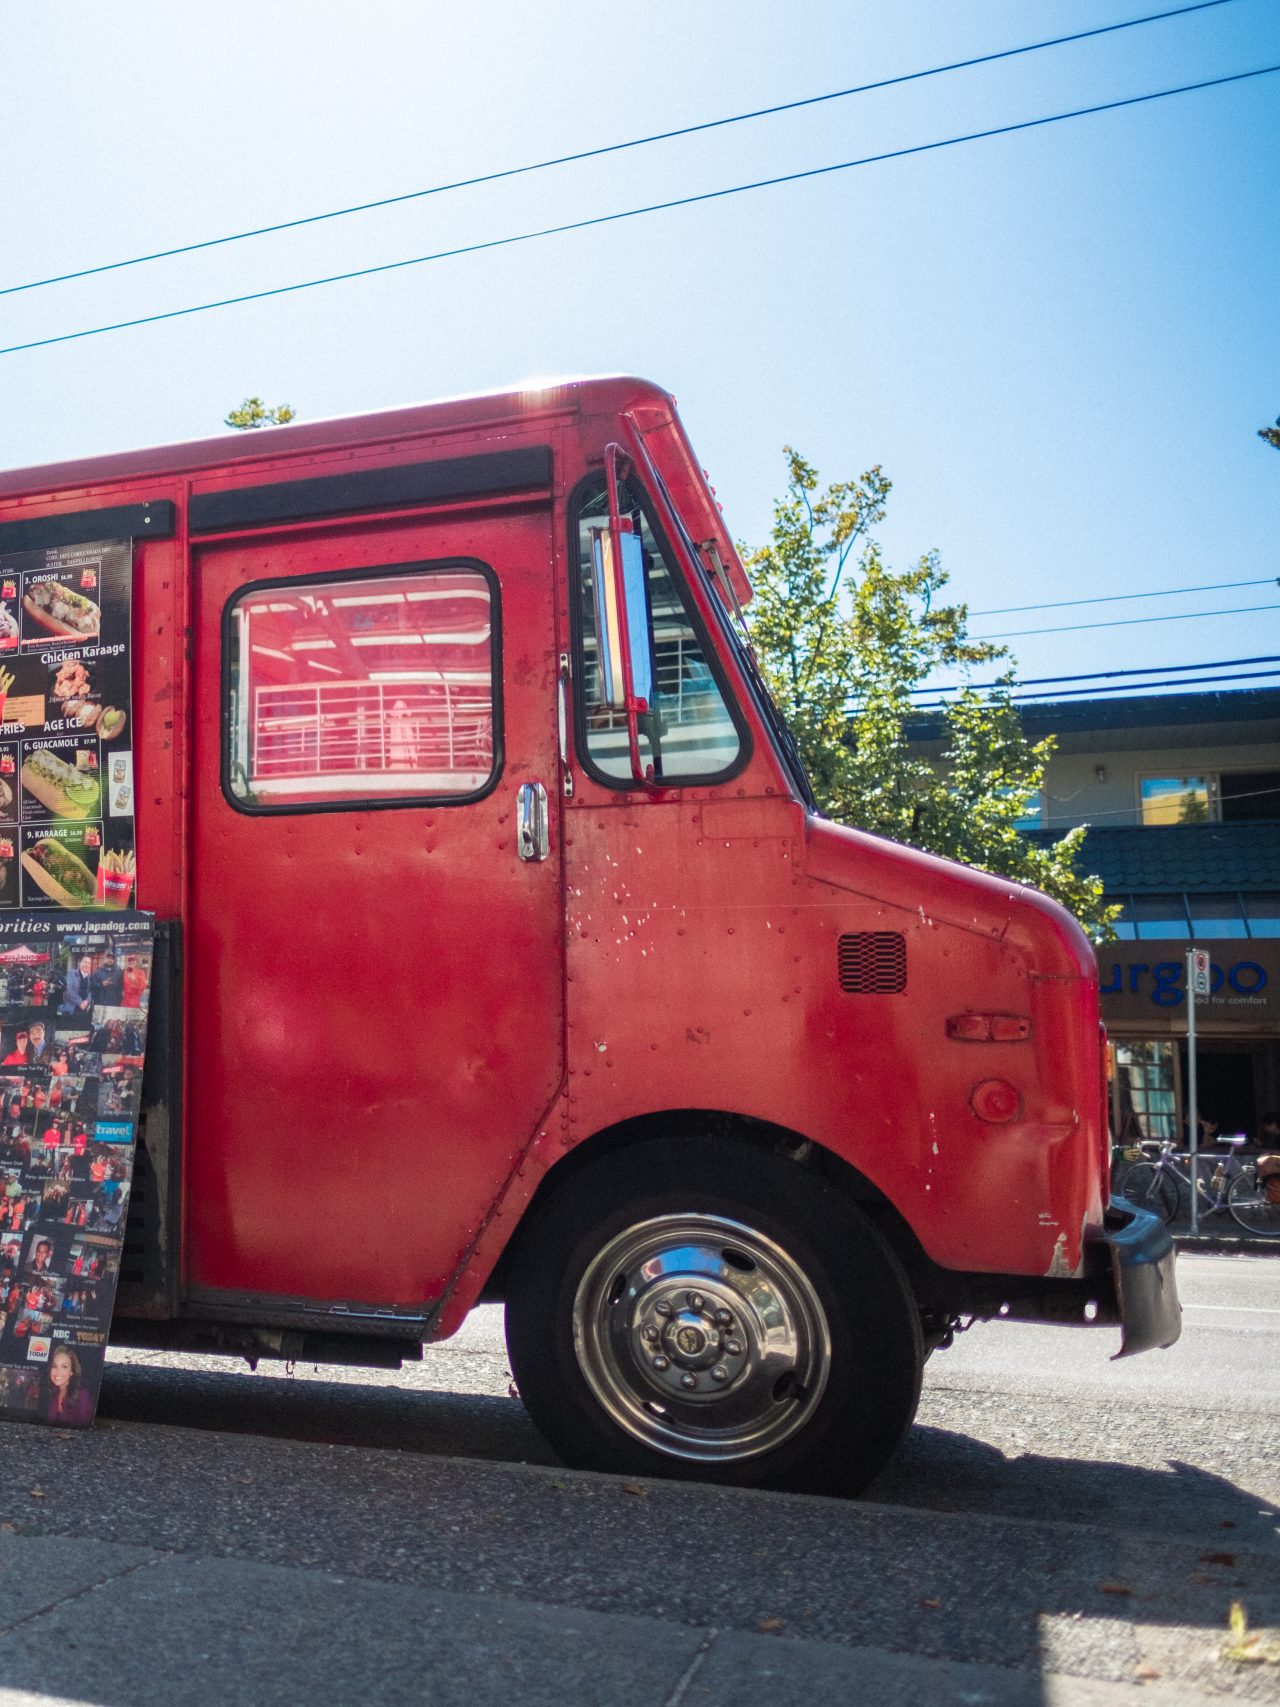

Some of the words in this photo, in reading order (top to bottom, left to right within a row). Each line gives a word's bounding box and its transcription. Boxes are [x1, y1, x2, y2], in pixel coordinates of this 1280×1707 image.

[24, 577, 32, 585] 3.
[32, 573, 59, 584] OROSHI
[41, 650, 80, 664] Chicken
[82, 643, 125, 657] Karaage
[43, 719, 65, 732] AGE
[66, 717, 83, 729] ICE
[24, 742, 32, 750] 6.
[32, 739, 79, 750] GUACAMOLE
[26, 831, 34, 839] 9.
[35, 829, 68, 838] KARAAGE
[56, 920, 150, 934] www.japadog.com
[1211, 995, 1225, 1005] for
[1228, 995, 1267, 1005] comfort
[96, 1124, 131, 1136] travel
[52, 1329, 71, 1339] NBC
